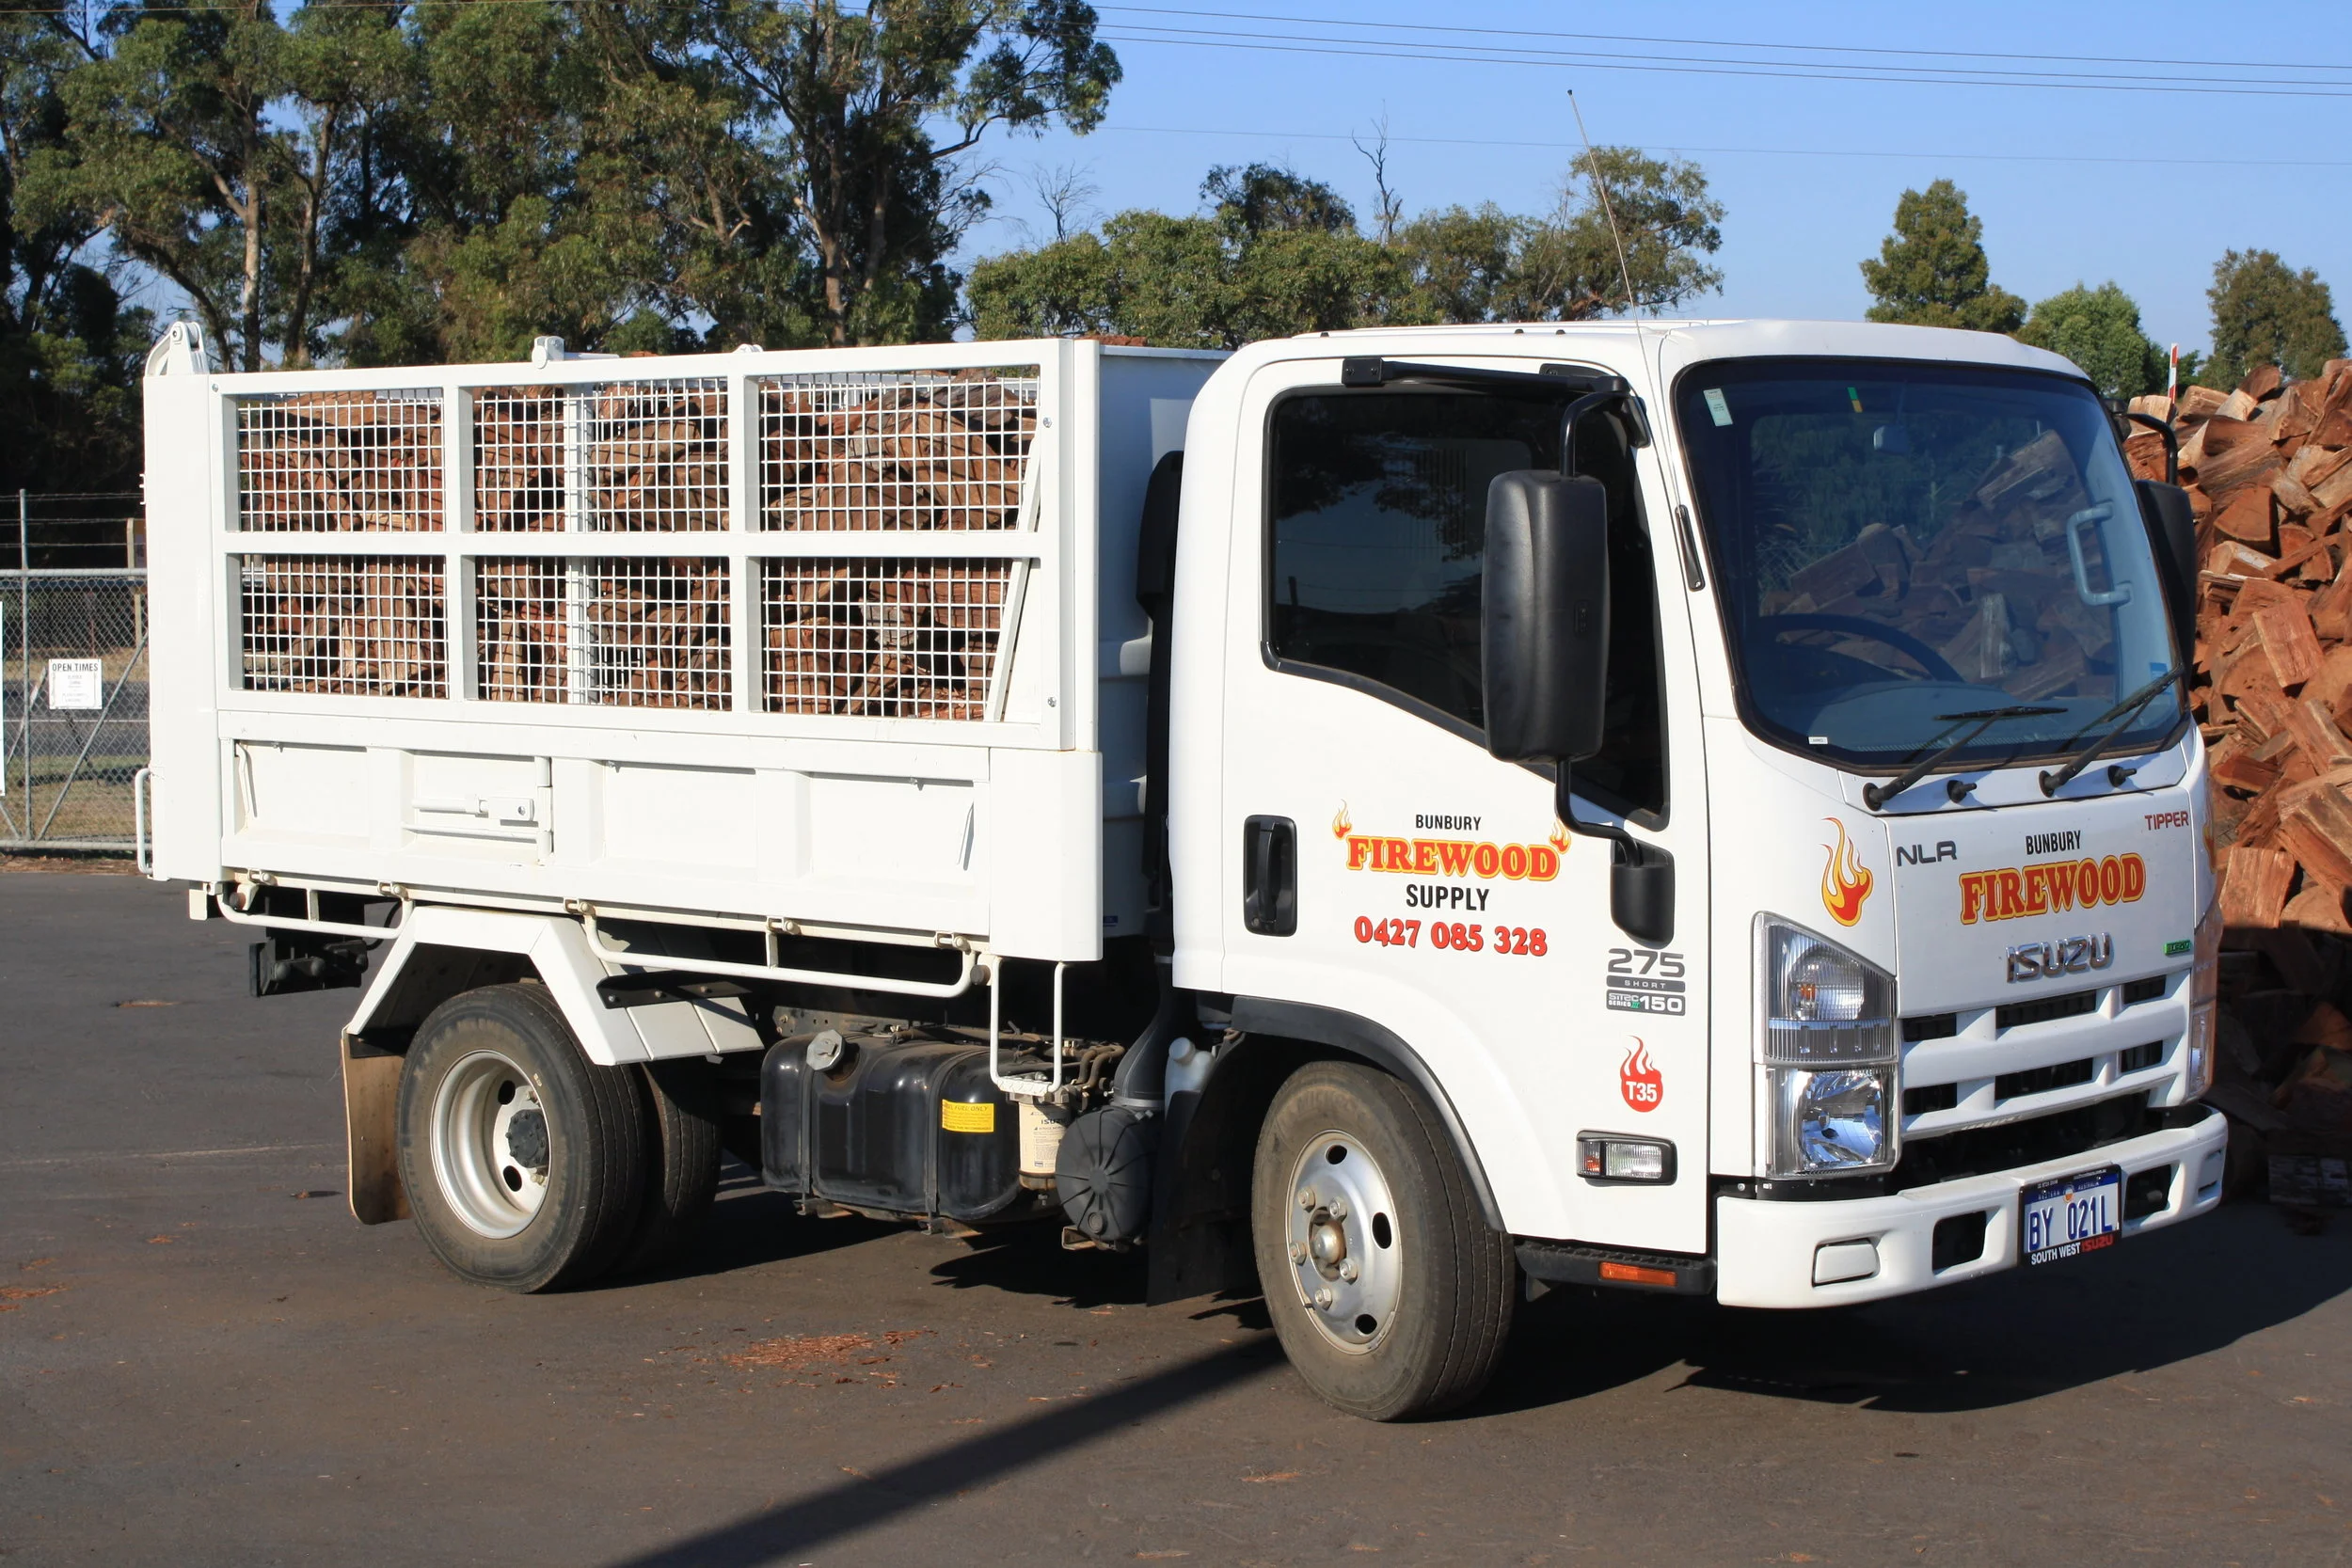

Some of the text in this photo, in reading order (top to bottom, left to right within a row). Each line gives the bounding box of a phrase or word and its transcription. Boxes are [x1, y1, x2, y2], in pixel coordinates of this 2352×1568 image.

[52, 663, 99, 672] OPEN TIMES
[1415, 815, 1482, 831] BUNBURY
[2144, 810, 2189, 831] TIPPER
[1897, 840, 1958, 867] NLR
[2026, 830, 2081, 855] BUNBURY
[1346, 834, 1560, 881] FIREWOOD
[1406, 883, 1489, 911] SUPPLY
[1959, 852, 2146, 926] FIREWOOD
[1354, 915, 1548, 957] 0427 085 328
[1608, 947, 1685, 978] 275
[2006, 932, 2112, 984] ISUZU
[1624, 979, 1666, 989] SHORT
[1639, 995, 1682, 1012] 150
[1625, 1081, 1658, 1102] T35
[2028, 1195, 2113, 1253] BY 021L
[2030, 1235, 2114, 1266] SOUTH WEST ISUZU
